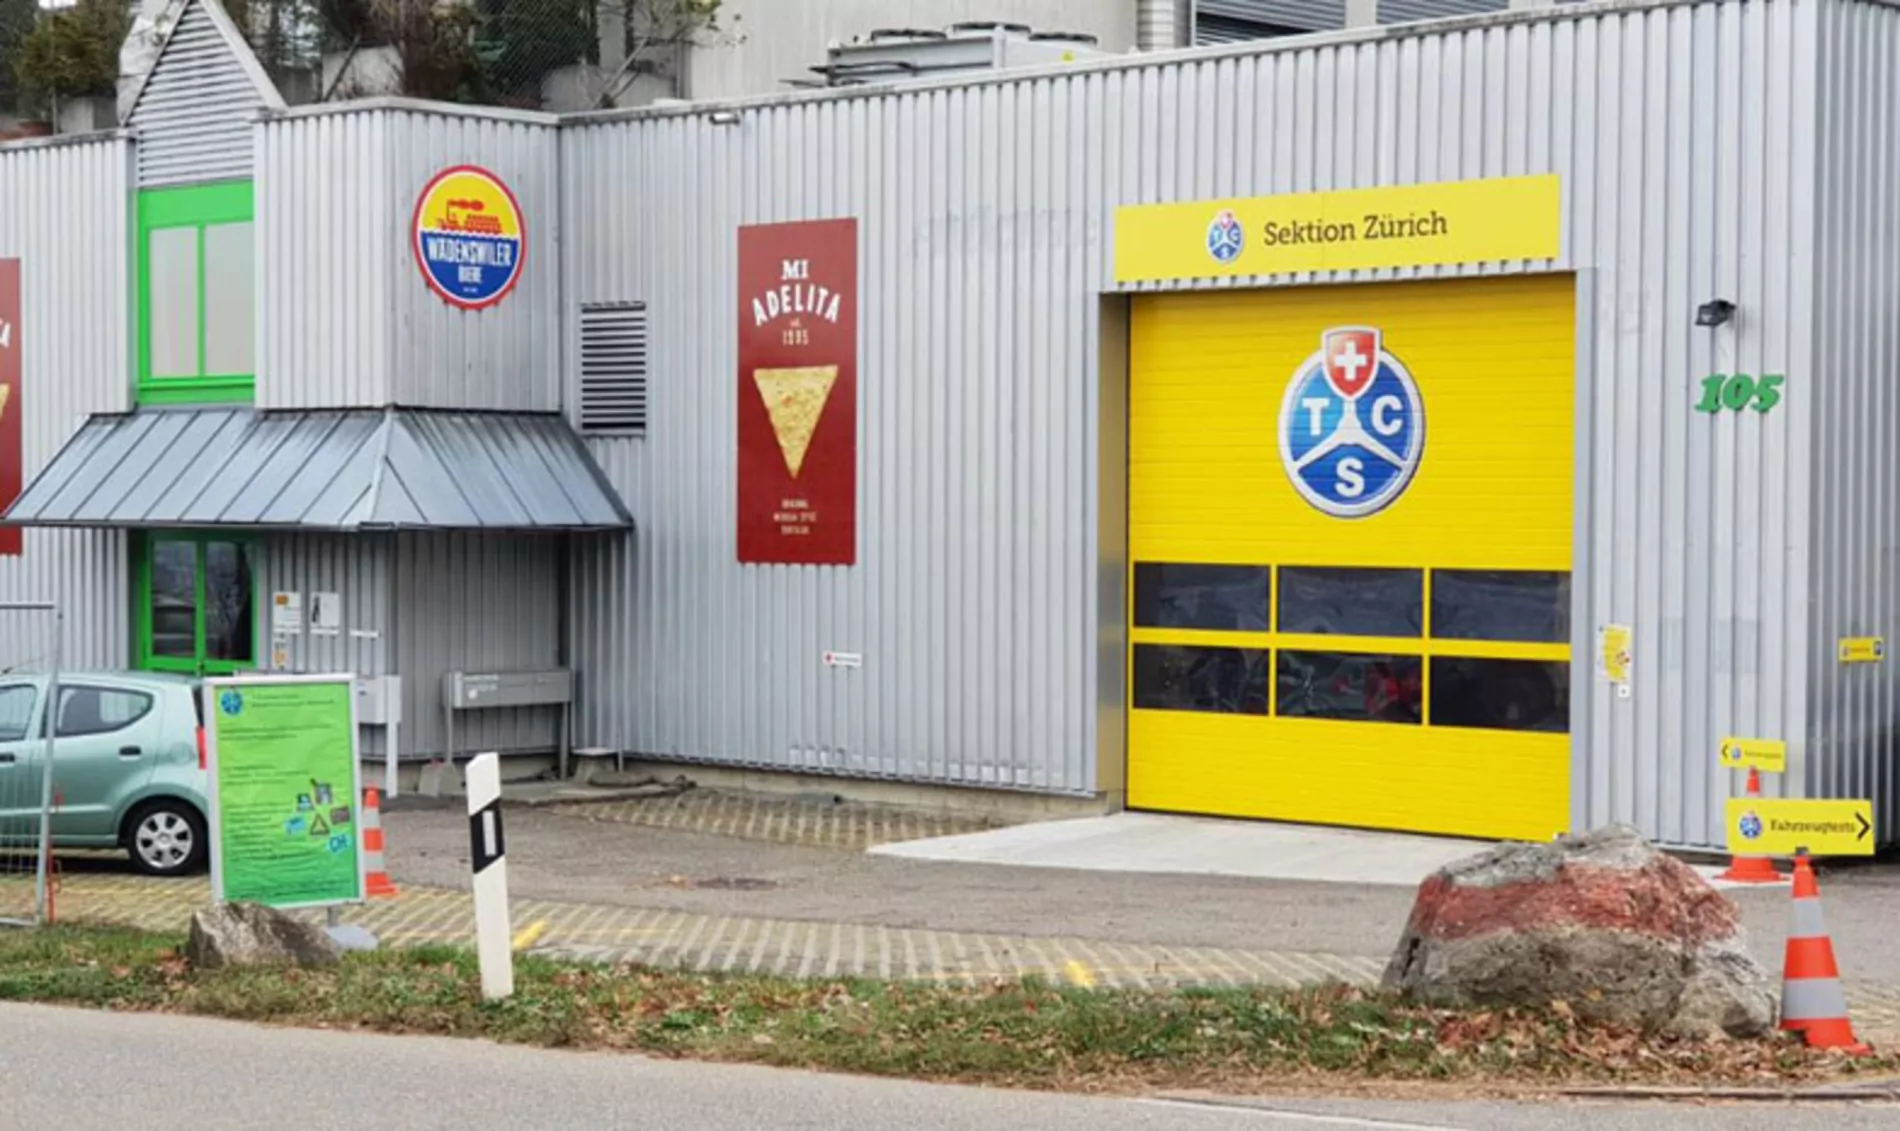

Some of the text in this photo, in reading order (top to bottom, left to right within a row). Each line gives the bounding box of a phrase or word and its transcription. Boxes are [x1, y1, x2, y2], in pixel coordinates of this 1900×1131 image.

[1263, 210, 1448, 247] Sektion Zürich
[781, 259, 809, 280] MI
[752, 283, 841, 327] ADELITA
[1693, 373, 1785, 415] 105
[1770, 818, 1856, 834] Fahrzeugtests
